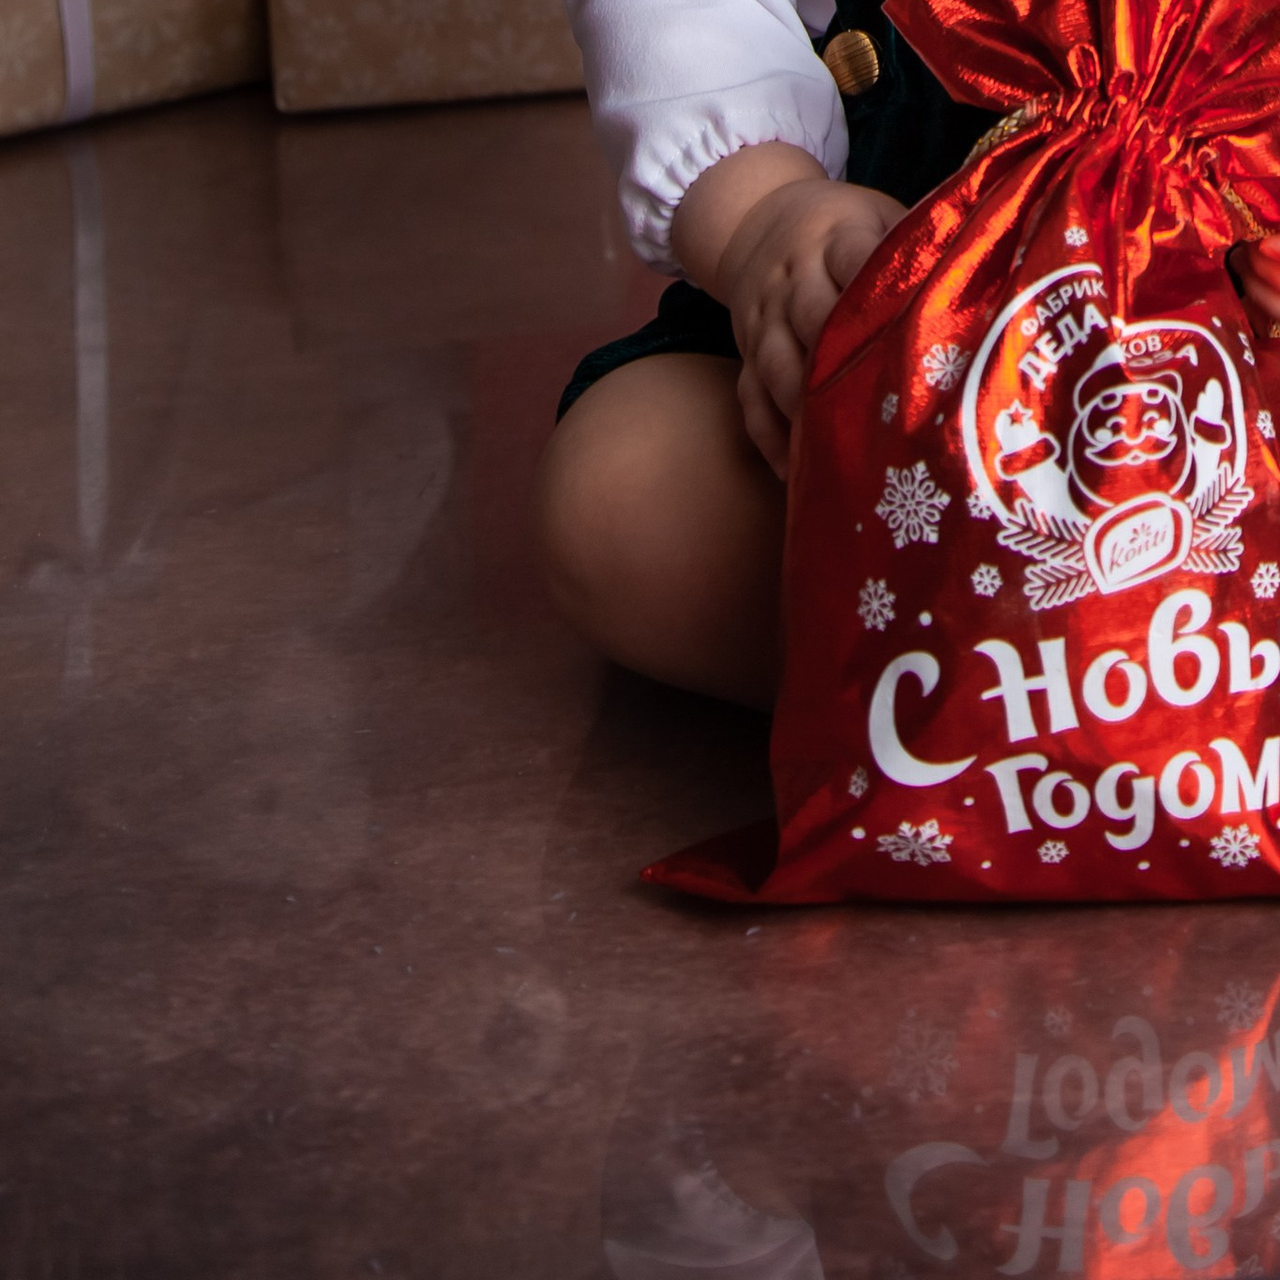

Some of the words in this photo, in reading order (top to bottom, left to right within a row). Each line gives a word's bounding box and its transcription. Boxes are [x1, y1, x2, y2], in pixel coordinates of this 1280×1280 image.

[1018, 303, 1108, 391] ДЕДА
[1020, 278, 1107, 336] ФАБРИК
[869, 652, 976, 787] С
